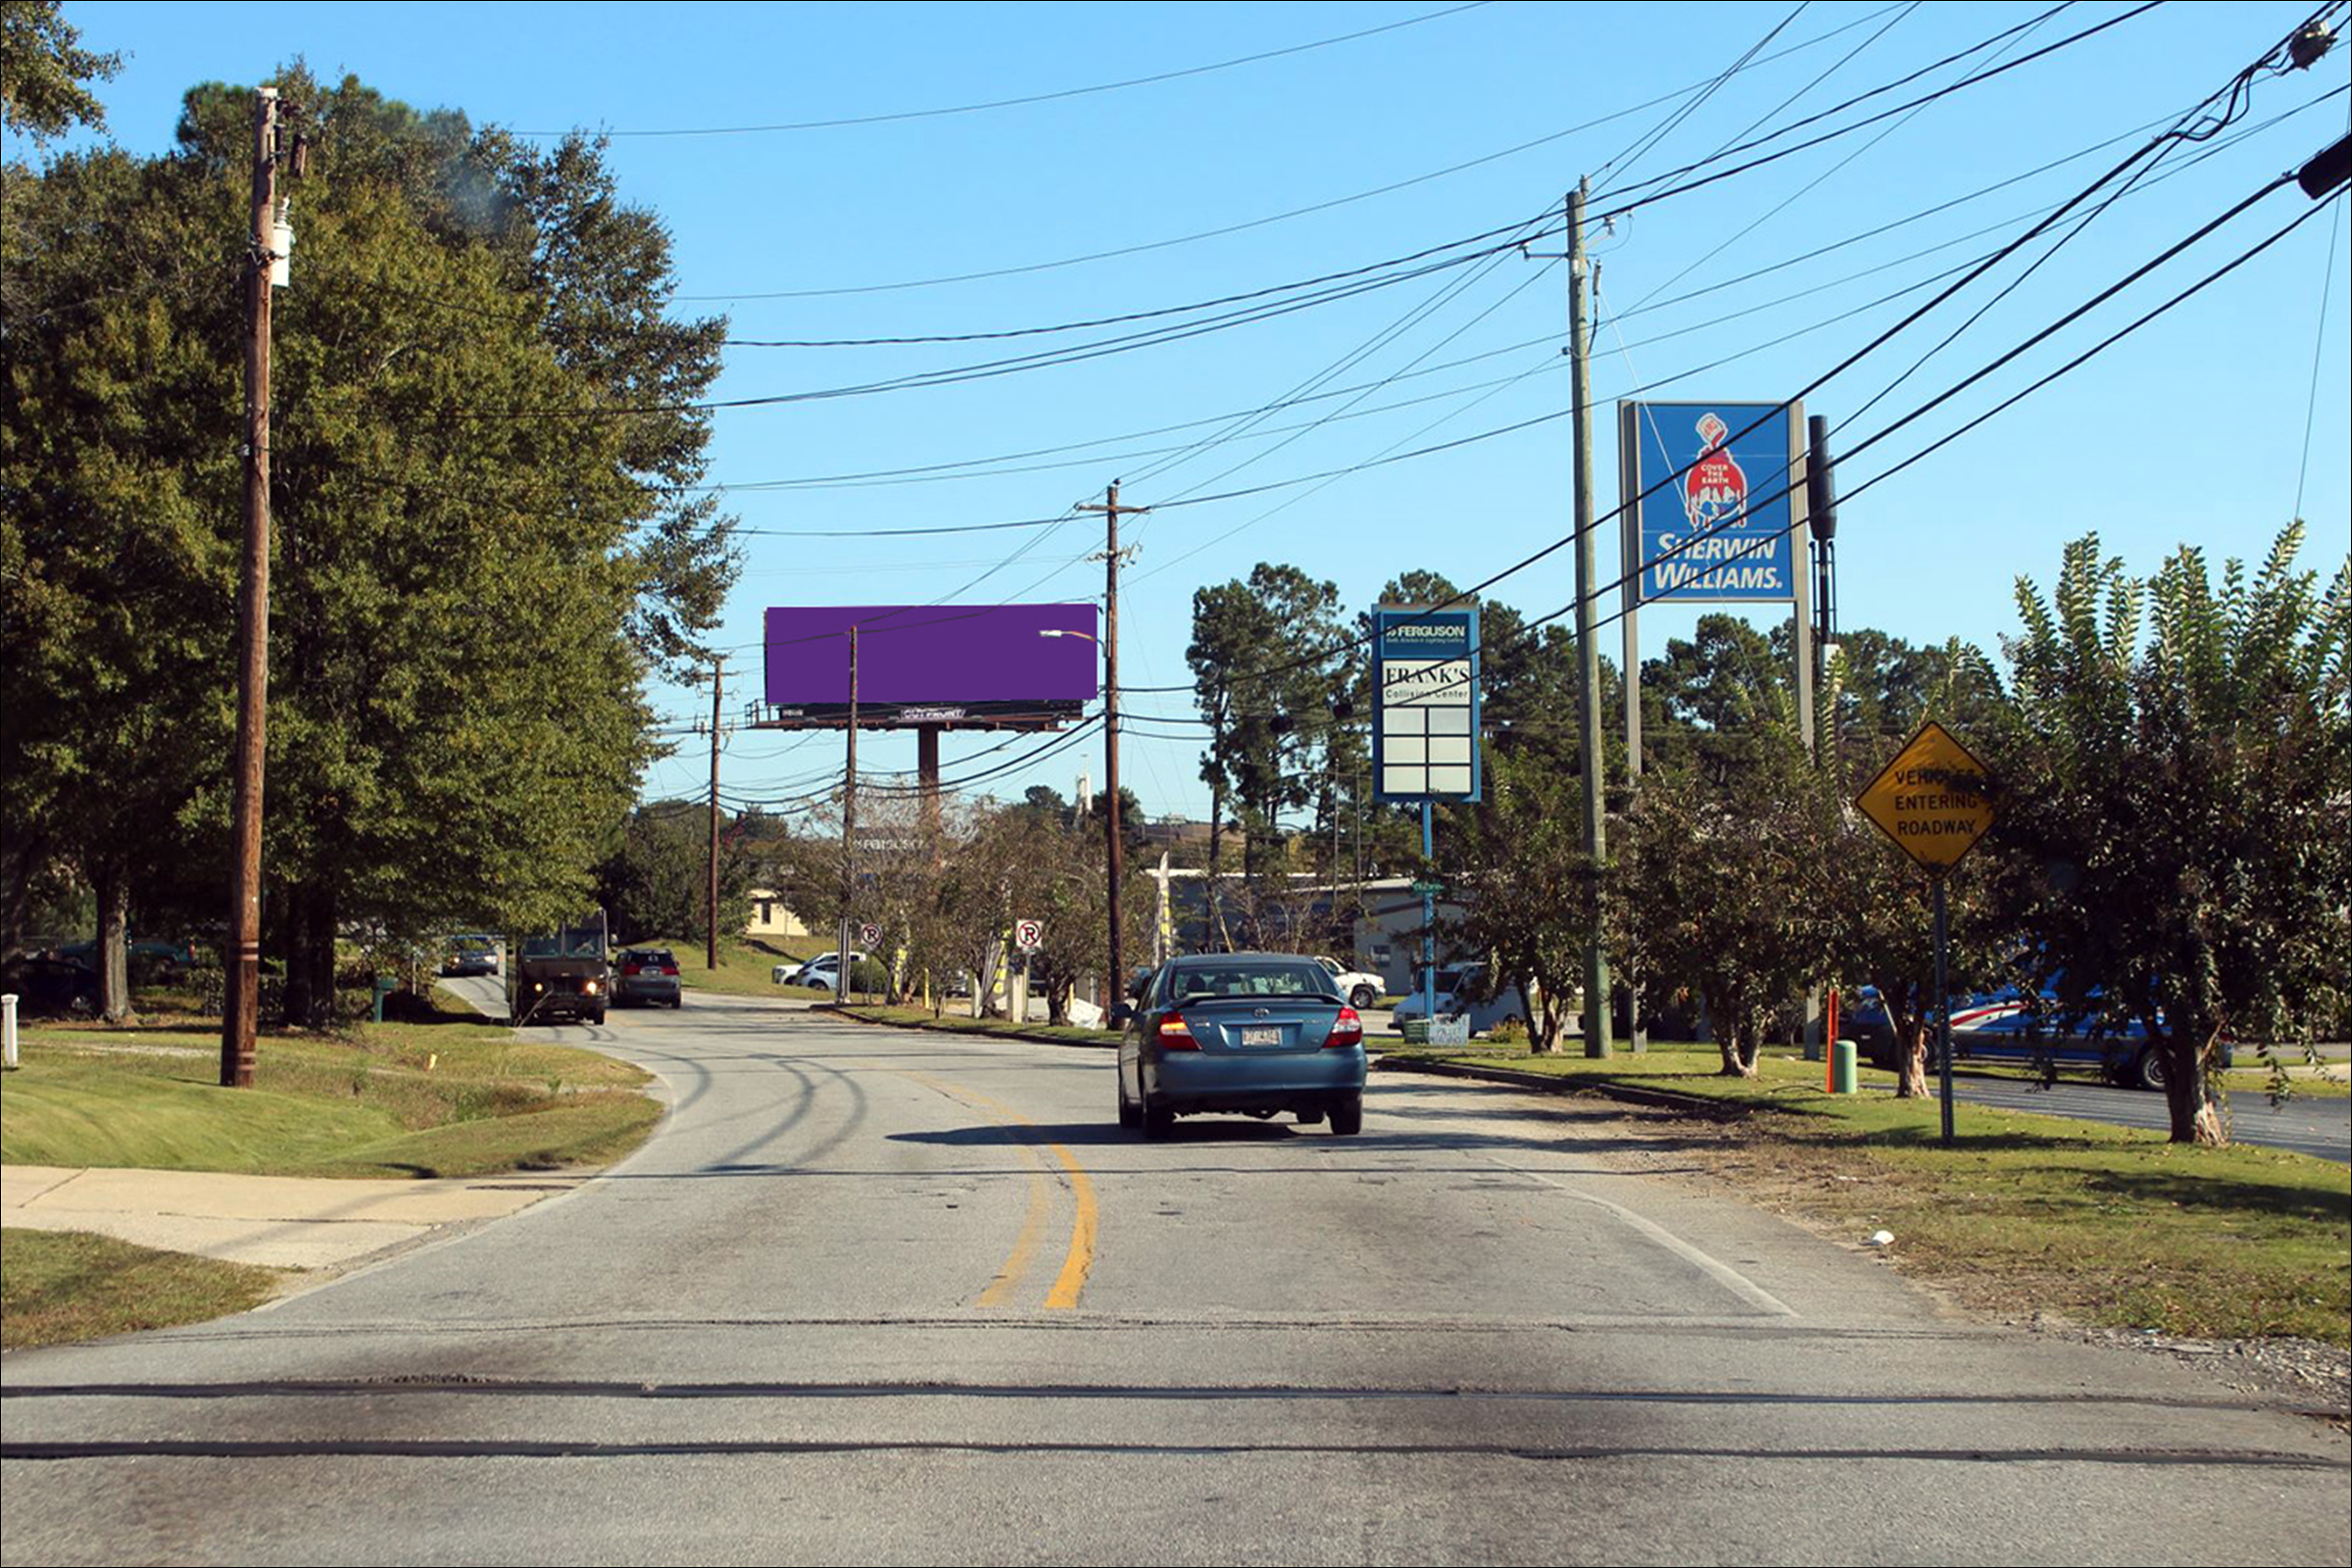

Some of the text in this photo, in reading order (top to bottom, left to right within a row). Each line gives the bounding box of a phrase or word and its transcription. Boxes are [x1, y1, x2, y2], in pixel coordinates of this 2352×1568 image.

[1655, 533, 1777, 560] SHERWIN
[1398, 625, 1465, 637] FERGUSON
[1386, 667, 1469, 683] FRANK'S
[1386, 689, 1468, 698] Collision Center
[1895, 795, 1978, 810] ENTERING
[1897, 819, 1976, 835] ROADWAY
